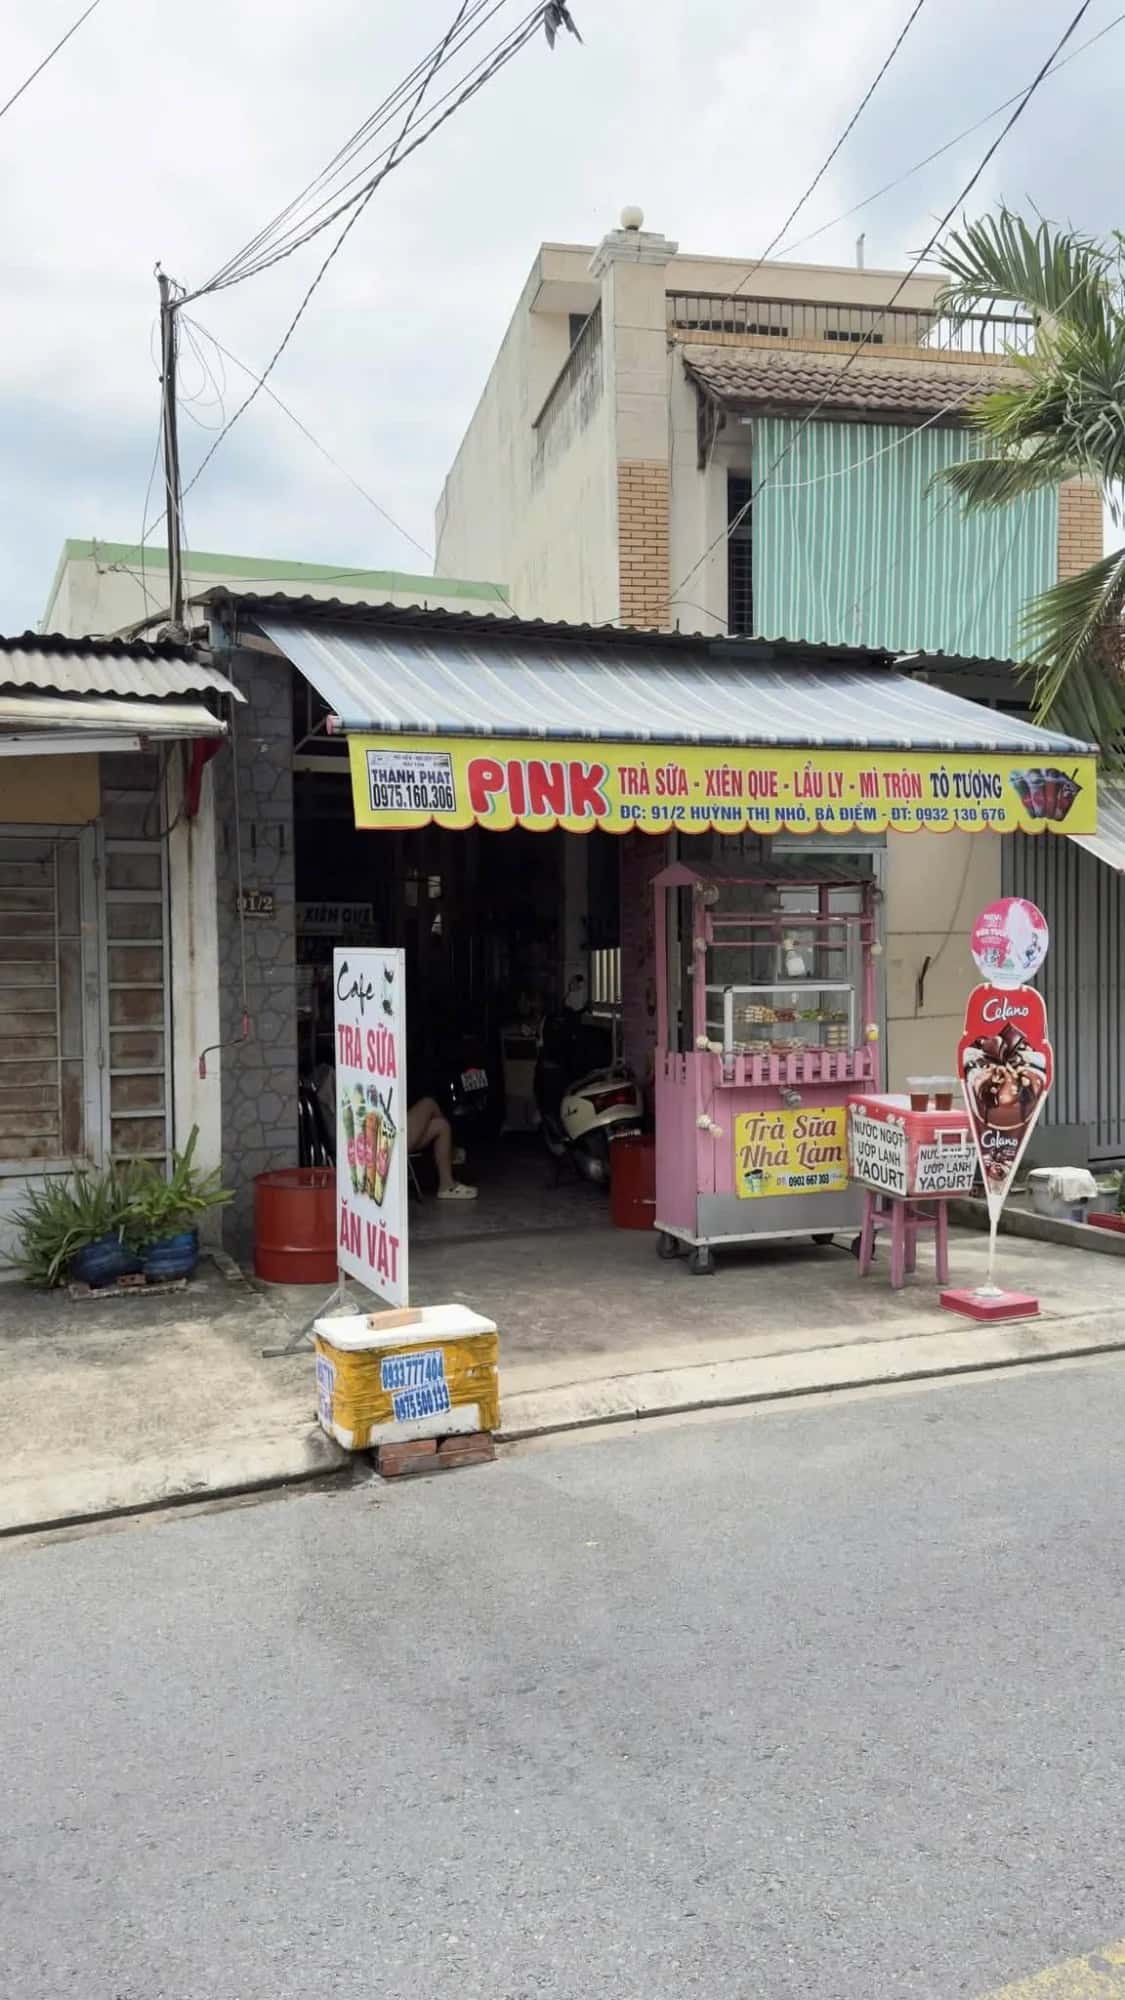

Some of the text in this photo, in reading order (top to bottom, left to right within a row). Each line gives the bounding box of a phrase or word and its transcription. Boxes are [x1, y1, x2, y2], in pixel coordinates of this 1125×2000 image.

[468, 757, 612, 817] PINK
[618, 761, 689, 796] TRÀ SỮA
[705, 764, 779, 799] XIÊN QUE
[828, 771, 844, 798] LY
[859, 767, 922, 804] MÌ TRỘN
[930, 765, 1002, 805] TÔ TƯỢNG
[373, 783, 453, 808] 0975.160.306
[620, 805, 646, 819] ĐC:
[651, 806, 685, 820] 91/2
[691, 803, 742, 820] HUỲNH
[747, 806, 770, 823] THỊ
[816, 804, 835, 821] BÀ
[840, 802, 876, 820] ĐIỂM
[892, 808, 912, 820] ĐT:
[916, 808, 948, 820] 0932
[955, 808, 977, 821] 130
[982, 808, 1005, 821] 676
[337, 961, 375, 1016] Cafe
[982, 997, 1029, 1022] Celano
[338, 1018, 397, 1079] TRÀ SỮA
[745, 1115, 837, 1141] Trà Sữa
[880, 1128, 903, 1149] NGỌT
[981, 1130, 1018, 1148] Celano
[740, 1140, 842, 1170] Nhà Làm
[340, 1199, 399, 1286] ĂN VẶT
